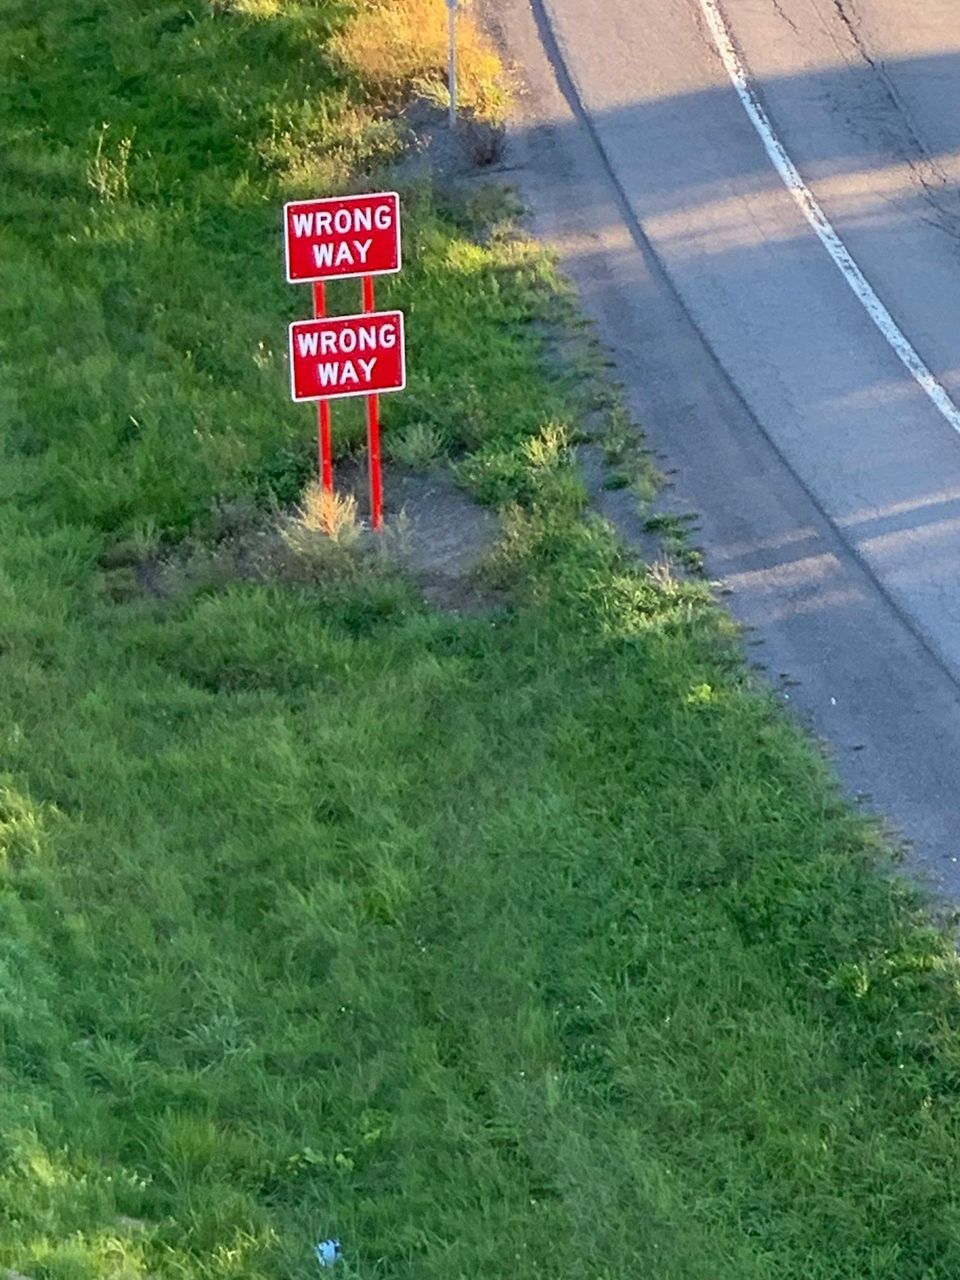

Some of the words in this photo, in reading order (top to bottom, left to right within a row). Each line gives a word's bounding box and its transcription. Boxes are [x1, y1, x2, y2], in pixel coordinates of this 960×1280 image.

[292, 205, 392, 238] WRONG
[312, 238, 373, 268] WAY
[297, 323, 396, 358] WRONG
[318, 357, 377, 387] WAY
